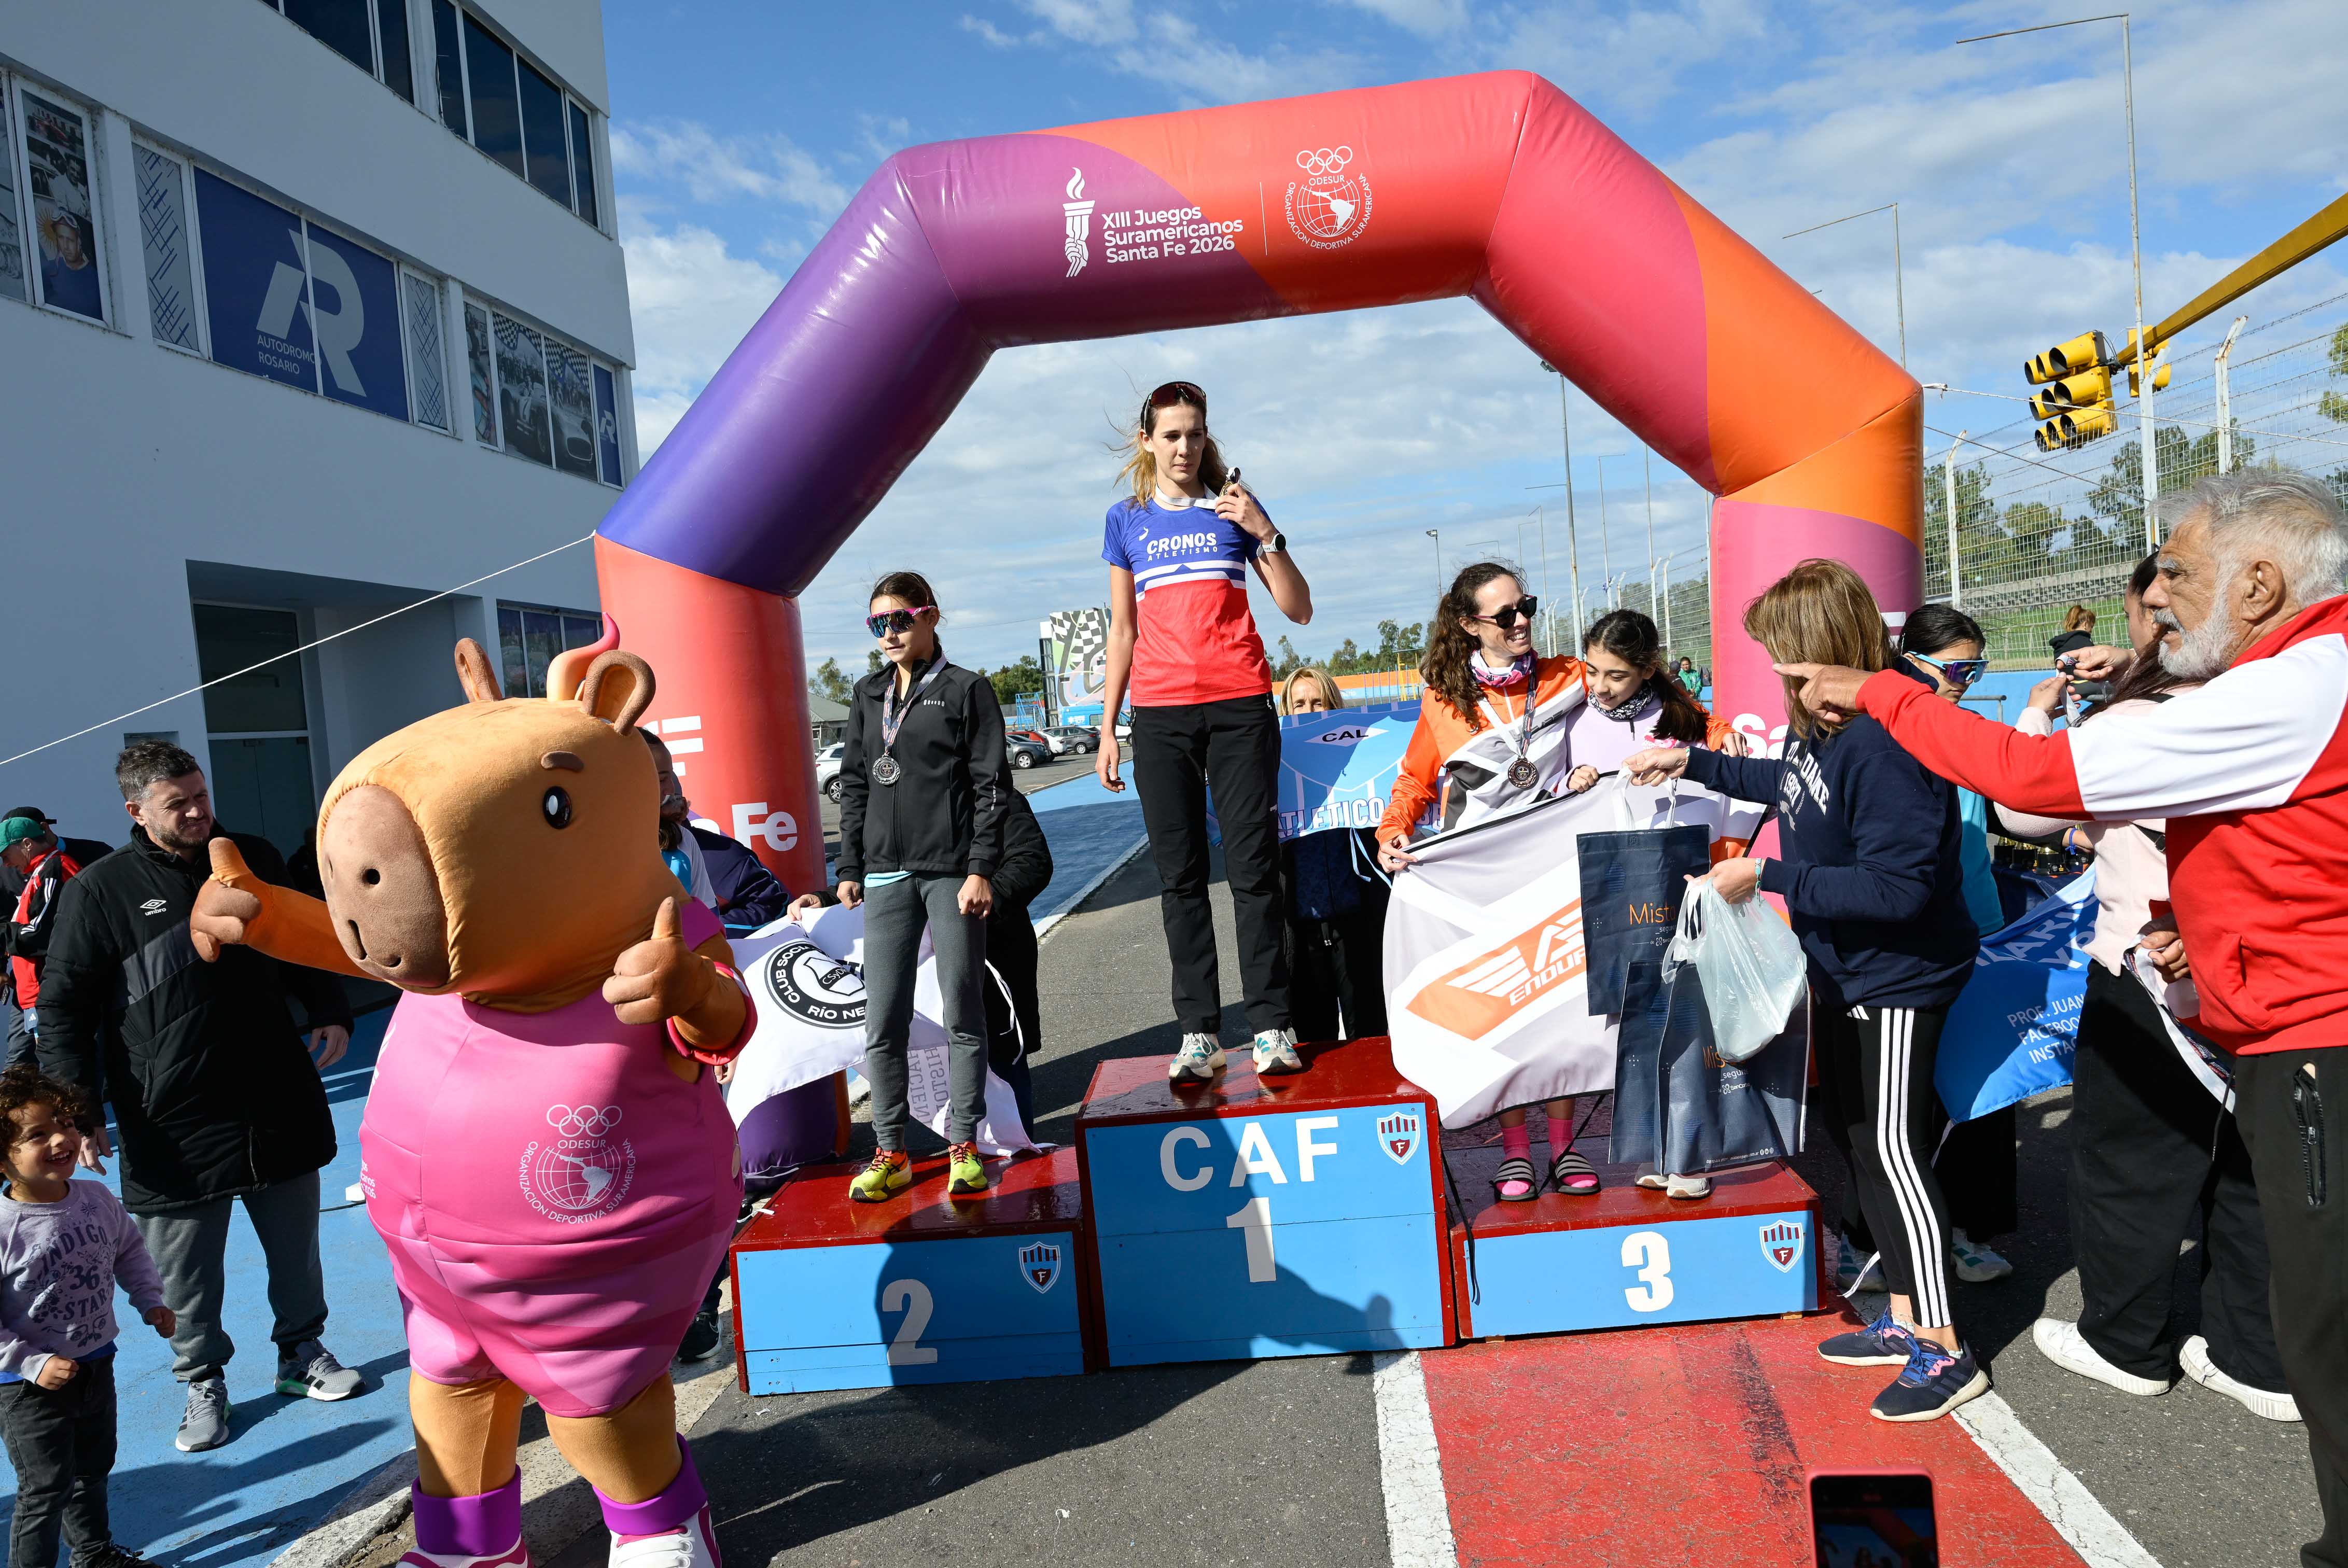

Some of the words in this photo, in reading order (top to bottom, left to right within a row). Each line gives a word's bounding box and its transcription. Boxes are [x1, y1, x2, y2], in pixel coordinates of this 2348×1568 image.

[1308, 174, 1345, 186] ODESUR
[1101, 211, 1131, 229] XIII
[1134, 206, 1202, 226] Juegos
[1285, 182, 1310, 245] ORGANIZACION
[1310, 236, 1353, 250] DEPORTIVA
[1352, 172, 1373, 239] SURAMERICANA
[1104, 219, 1243, 246] Suramericanos
[1106, 245, 1158, 263] Santa
[1163, 241, 1186, 257] Fe
[1189, 234, 1235, 254] 2026
[258, 351, 300, 375] ROSARIO
[1147, 533, 1217, 554] CRONOS
[1147, 546, 1218, 562] ATLETISMO
[1322, 729, 1369, 743] CAL
[732, 802, 798, 851] Fe
[776, 969, 800, 1003] CLUB
[807, 1005, 837, 1019] RÍO
[2017, 1015, 2081, 1046] FACEBOO
[557, 1140, 606, 1149] ODESUR
[1160, 1116, 1338, 1192] CAF
[519, 1141, 549, 1215] ORGANIZACION
[548, 1209, 607, 1224] DEPORTIVA
[606, 1138, 636, 1212] SURAMERICANA
[41, 1224, 108, 1272] INDIGO
[1226, 1197, 1276, 1283] 1
[70, 1265, 101, 1290] 36
[1622, 1231, 1674, 1312] 3
[883, 1279, 938, 1366] 2
